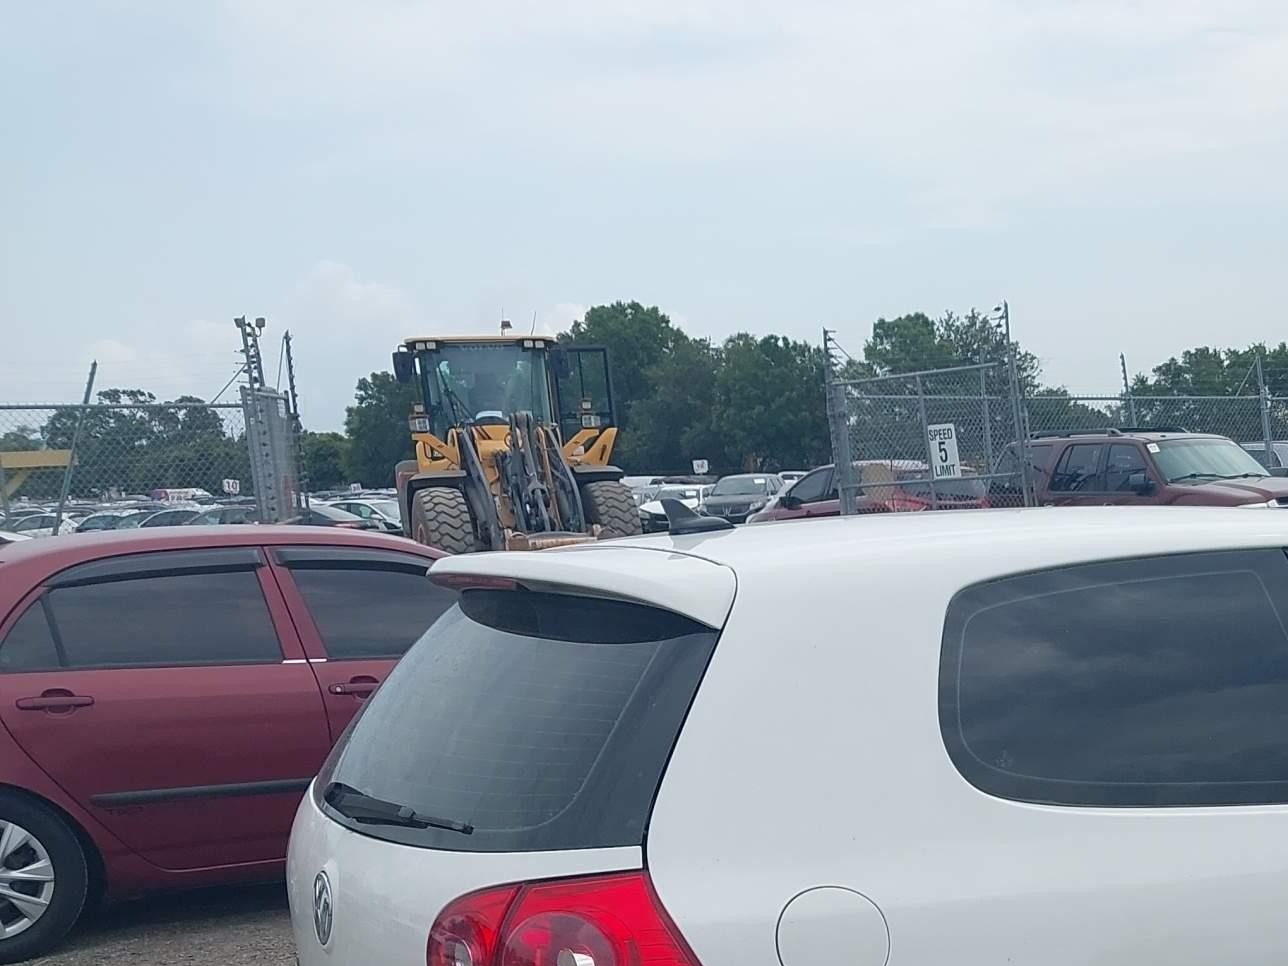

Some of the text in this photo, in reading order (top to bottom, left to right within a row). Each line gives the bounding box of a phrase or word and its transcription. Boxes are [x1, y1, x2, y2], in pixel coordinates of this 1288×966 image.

[928, 428, 953, 441] SPEED
[938, 441, 948, 463] 5
[934, 464, 956, 477] LIMIT
[225, 480, 238, 490] 10
